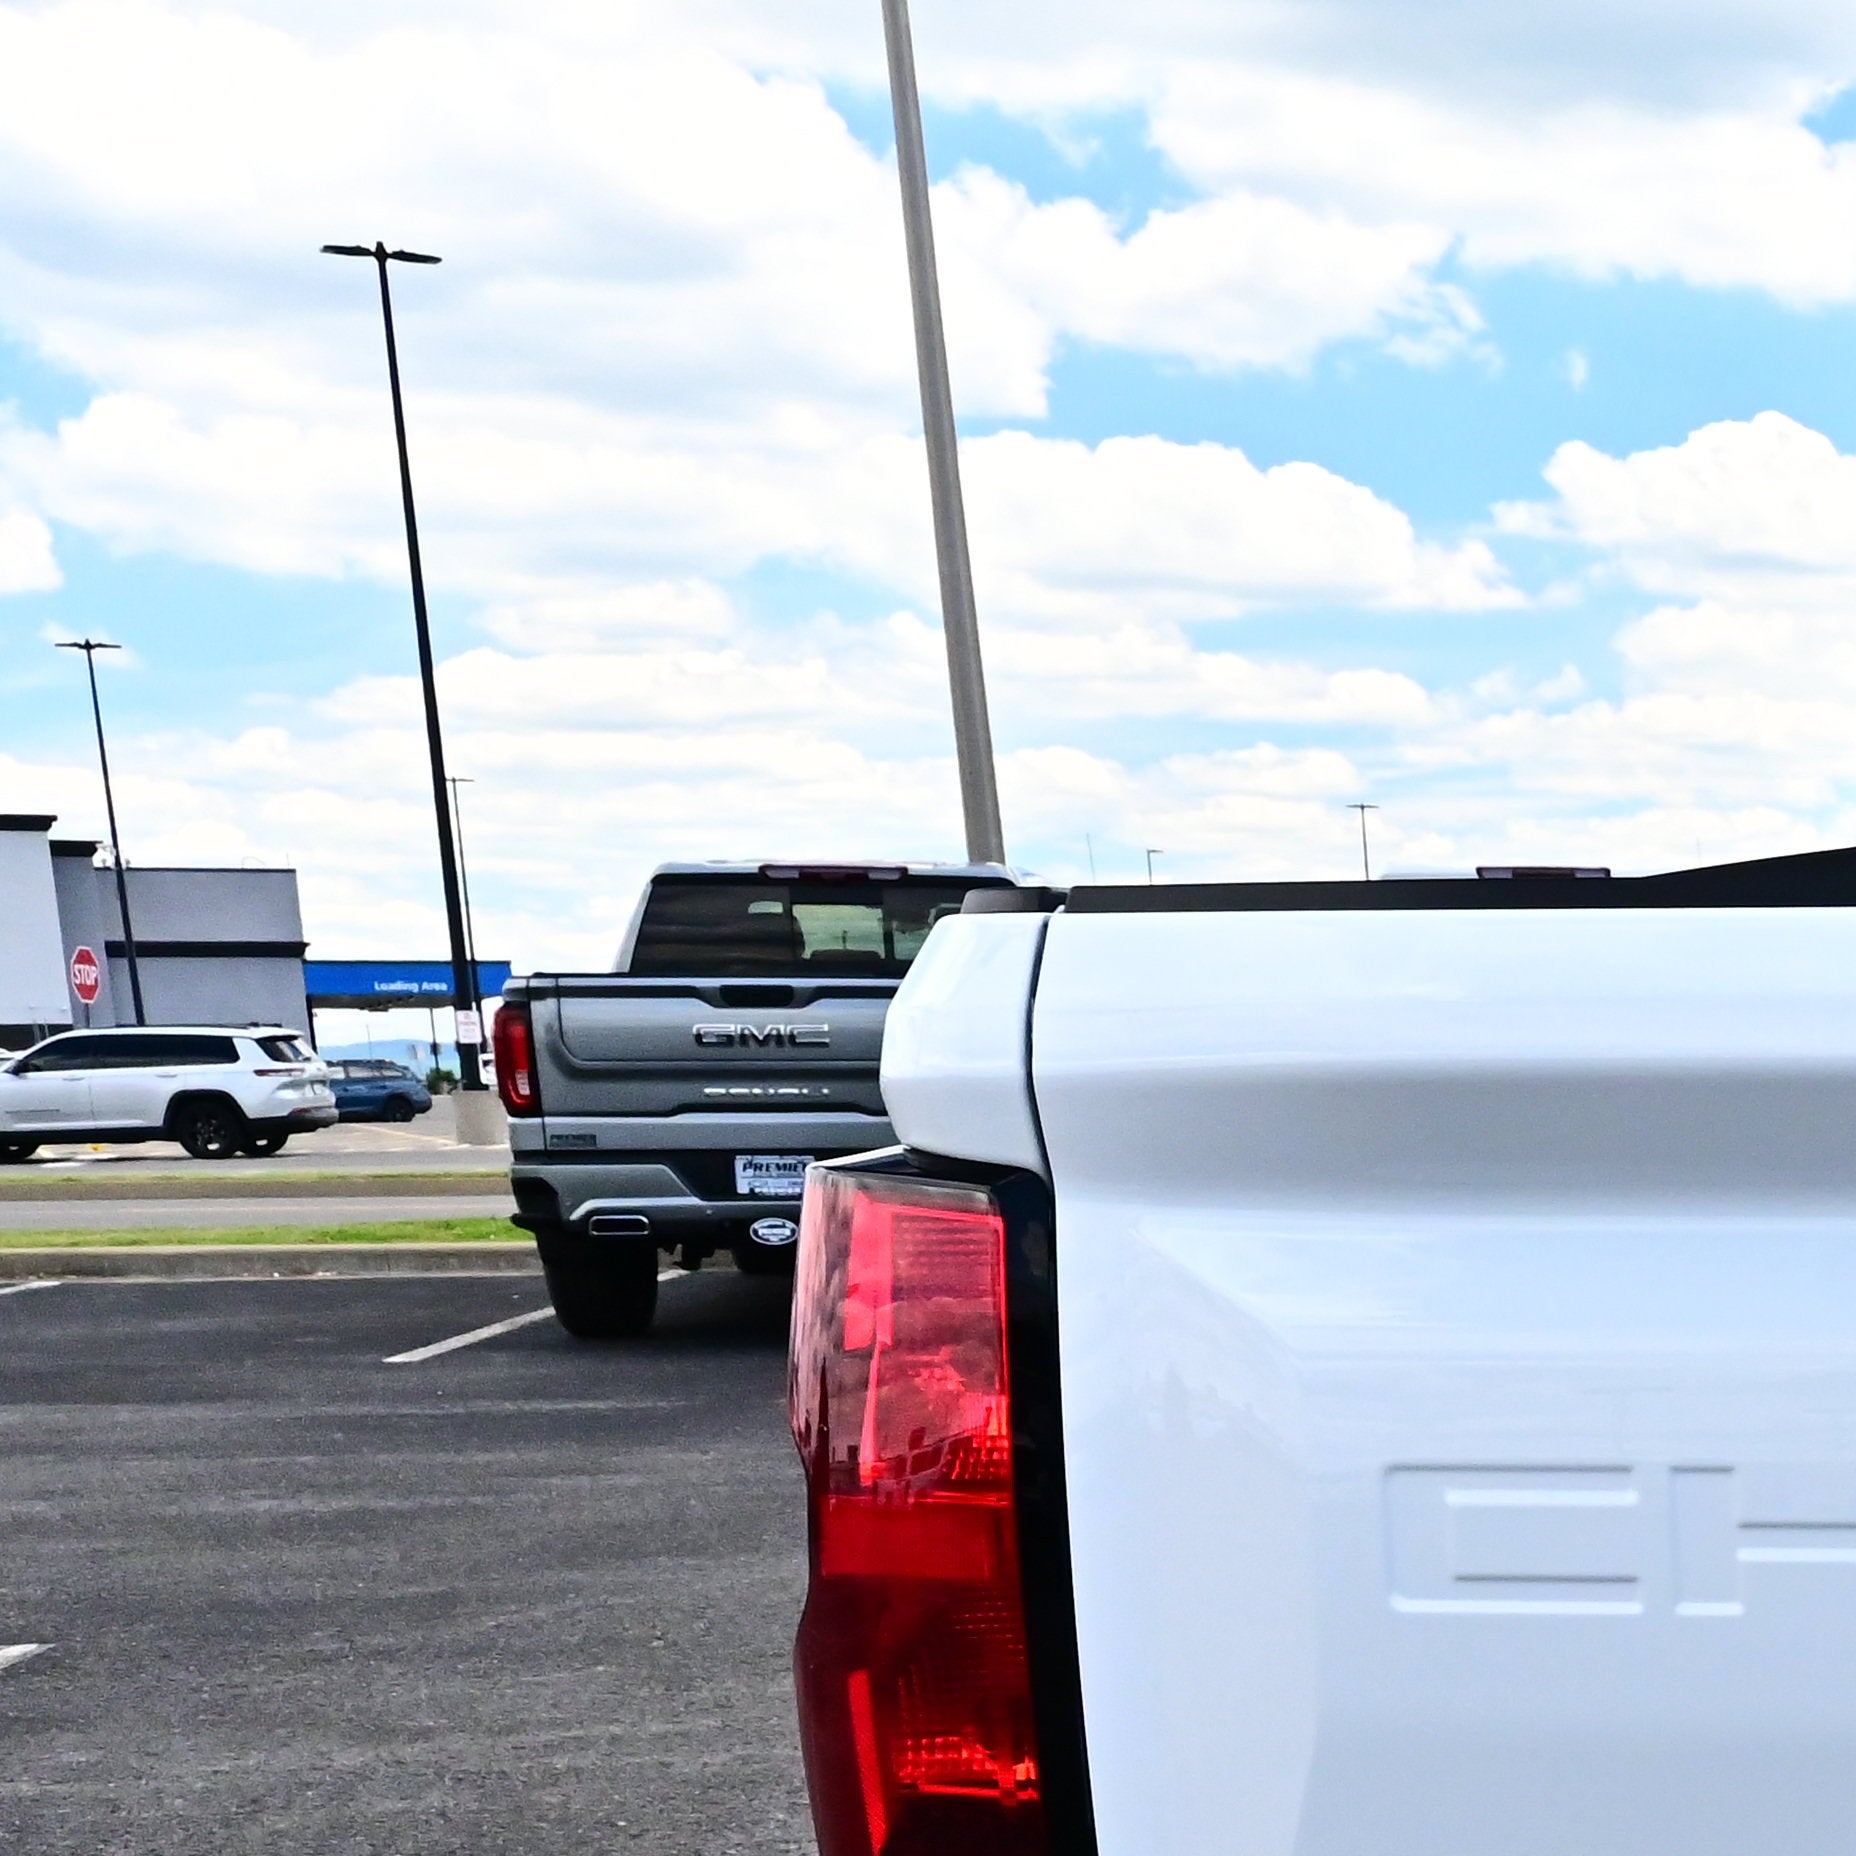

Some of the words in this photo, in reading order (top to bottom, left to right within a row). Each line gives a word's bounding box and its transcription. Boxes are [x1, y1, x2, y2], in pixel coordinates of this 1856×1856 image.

[74, 964, 98, 985] STOP
[374, 981, 419, 993] Loading
[421, 982, 448, 991] Area
[692, 1023, 830, 1048] GMC
